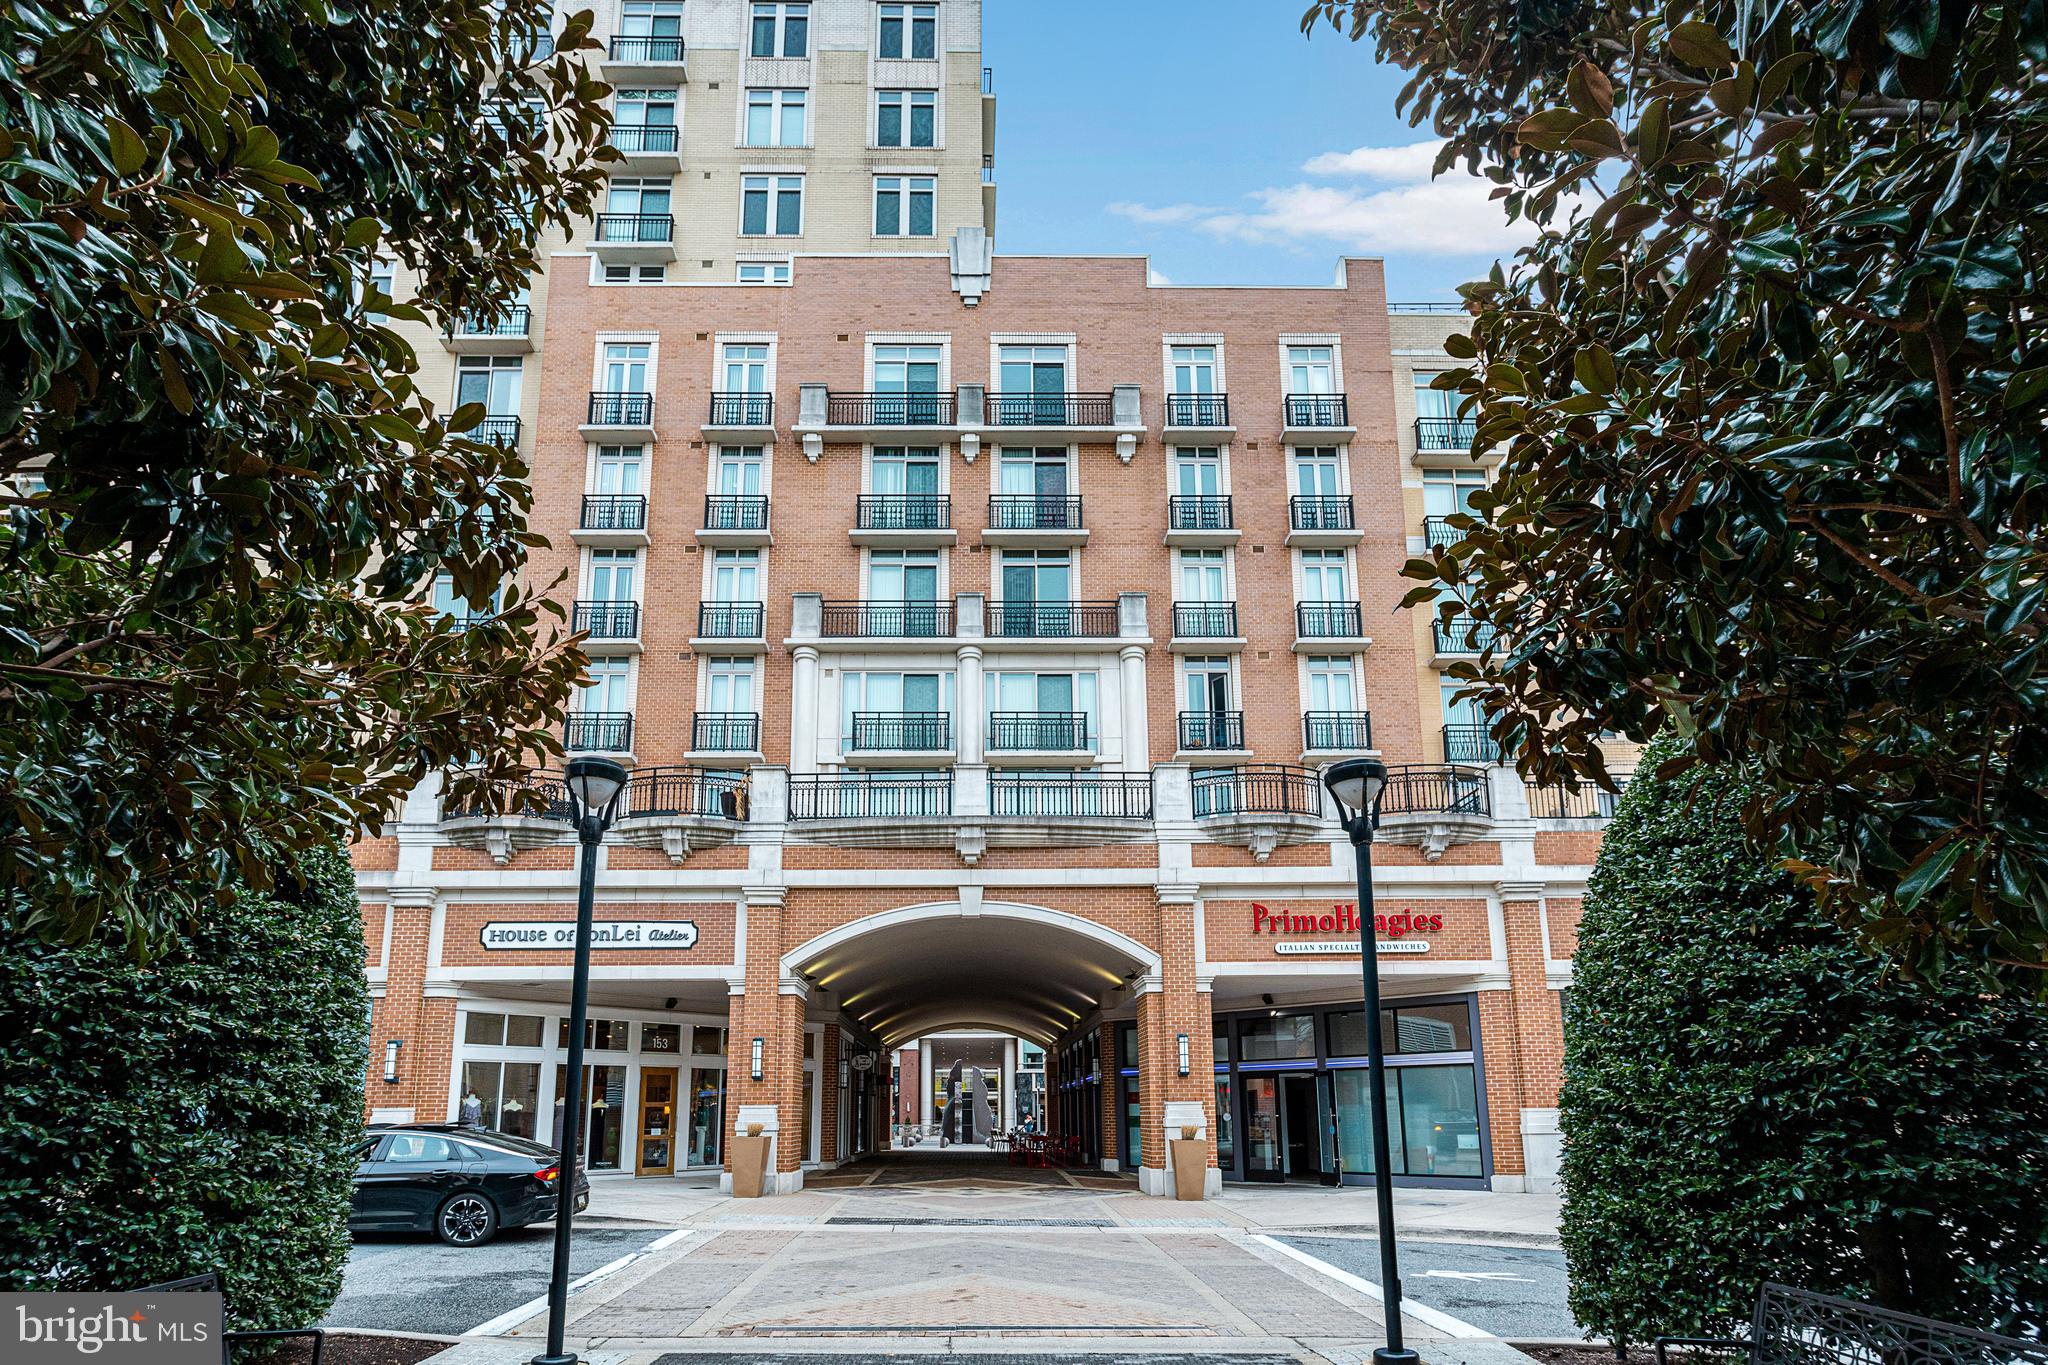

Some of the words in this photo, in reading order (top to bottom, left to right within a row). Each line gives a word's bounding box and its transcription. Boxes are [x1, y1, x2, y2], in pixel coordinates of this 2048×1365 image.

[488, 929, 548, 942] House
[554, 929, 576, 942] of
[589, 924, 641, 942] onLei
[648, 929, 690, 941] Atelier
[1374, 943, 1428, 951] ANDWICHES
[652, 1038, 669, 1049] 153
